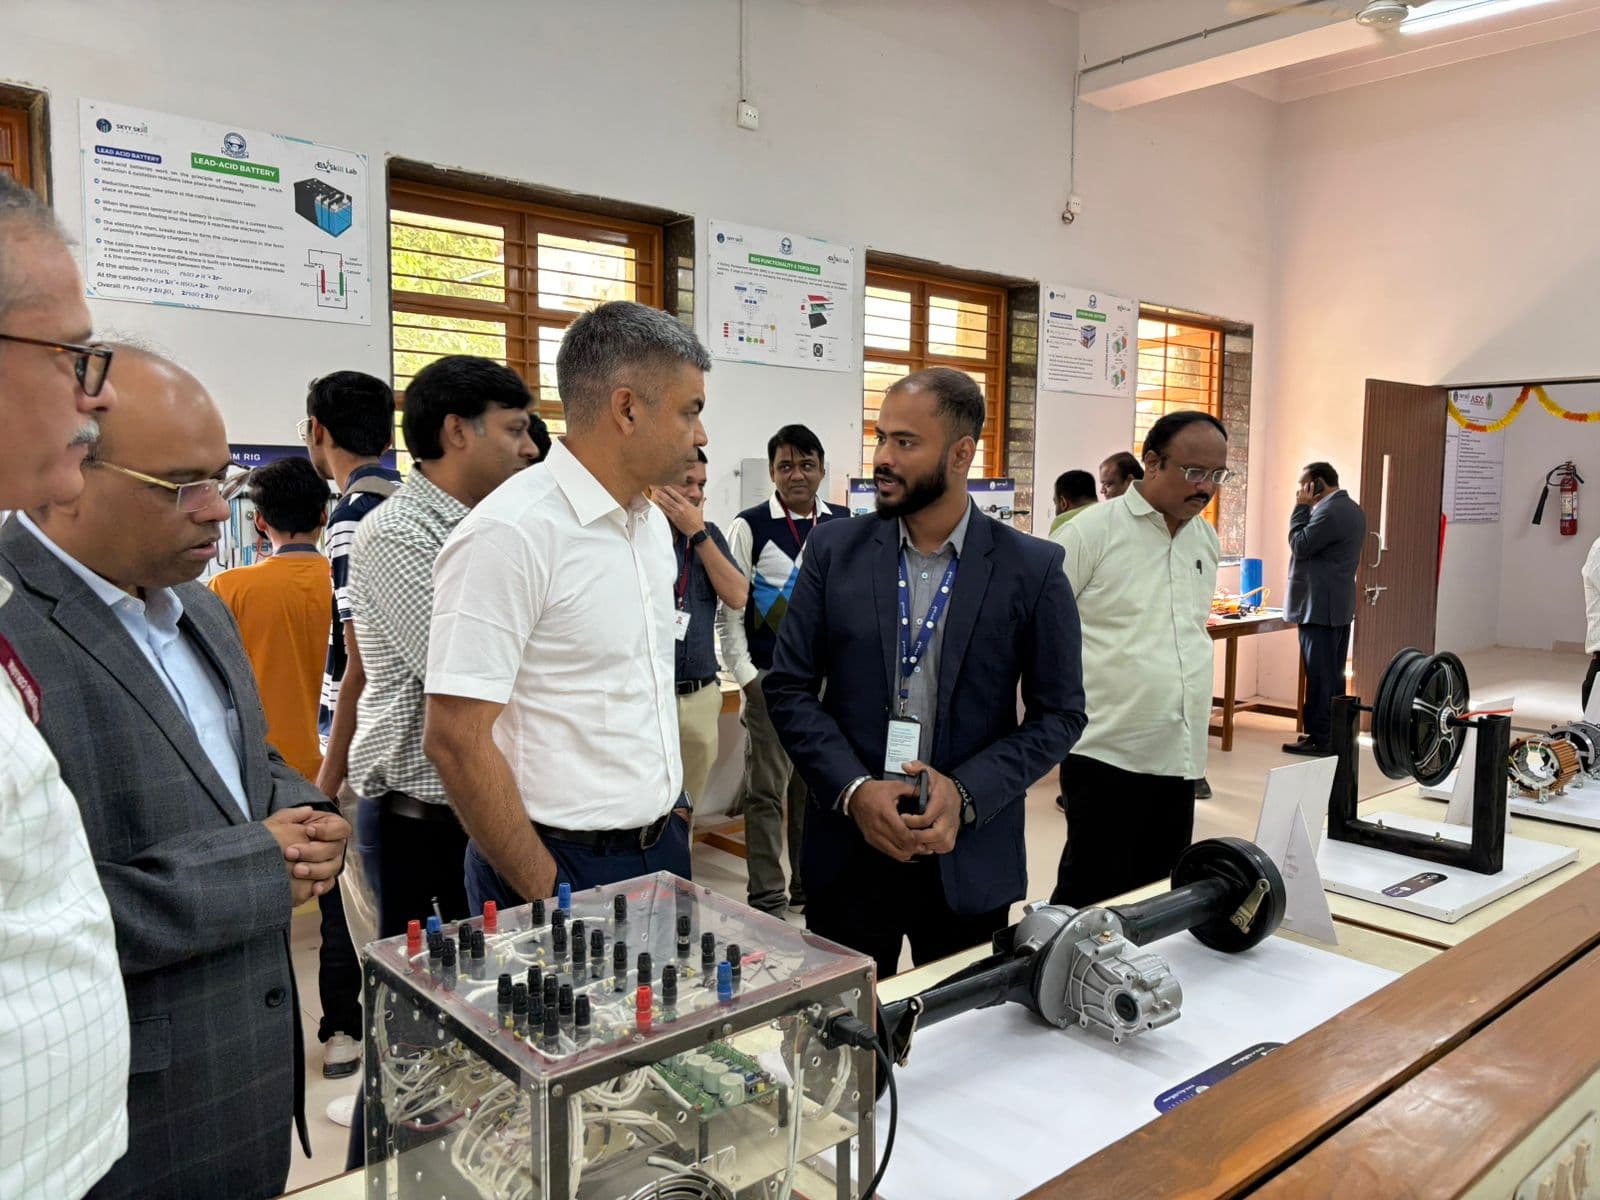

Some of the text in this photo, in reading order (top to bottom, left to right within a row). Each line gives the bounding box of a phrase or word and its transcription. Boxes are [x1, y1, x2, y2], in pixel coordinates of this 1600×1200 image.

[97, 147, 160, 163] LEAD ACID BATTERY
[193, 156, 276, 177] LEAD-ACID BATTERY
[345, 167, 358, 176] Lab
[243, 453, 261, 461] RIG
